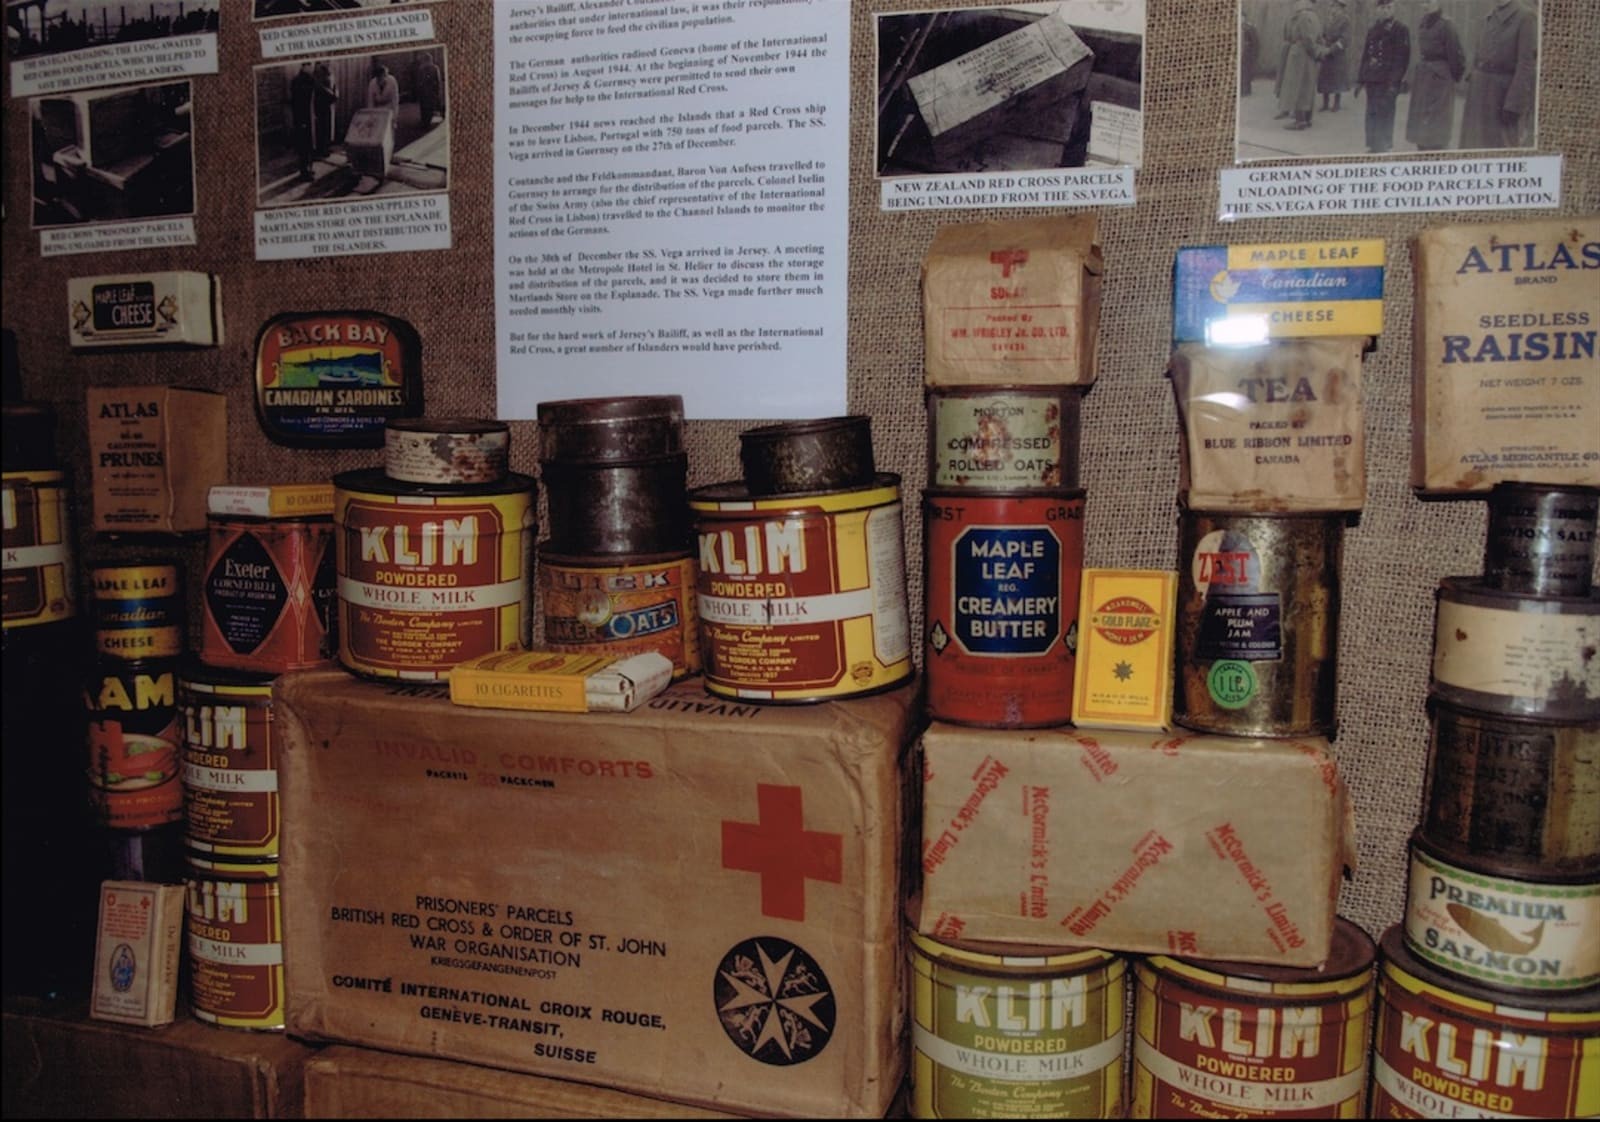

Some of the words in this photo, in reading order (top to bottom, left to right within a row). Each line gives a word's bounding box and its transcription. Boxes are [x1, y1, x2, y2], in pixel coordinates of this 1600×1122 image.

[262, 30, 280, 41] RED
[282, 28, 311, 39] CROSS
[312, 23, 354, 37] SUPPLIES
[356, 18, 387, 30] BEING
[388, 13, 428, 26] LANDED
[275, 45, 285, 53] AT
[288, 42, 304, 50] THE
[307, 38, 351, 48] HARBOUR
[355, 35, 364, 43] IN
[521, 122, 565, 134] December
[569, 120, 590, 130] 1944
[619, 116, 656, 127] reached
[659, 113, 675, 124] the
[678, 111, 712, 123] Islands
[715, 110, 735, 120] that
[749, 106, 768, 118] Red
[772, 105, 801, 116] Cross
[805, 104, 827, 116] ship
[1249, 170, 1312, 182] GERMAN
[1316, 167, 1388, 179] SOLDIERS
[1390, 164, 1457, 176] CARRIED
[1461, 163, 1492, 174] OUT
[1498, 162, 1527, 173] THE
[894, 182, 922, 193] NEW
[925, 179, 985, 192] ZEALAND
[988, 177, 1015, 189] RED
[1019, 175, 1061, 188] CROSS
[1064, 174, 1123, 186] PARCELS
[1238, 185, 1320, 198] UNLOADING
[1322, 183, 1343, 195] OF
[1347, 182, 1377, 194] THE
[1382, 180, 1424, 192] FOOD
[1428, 178, 1493, 191] PARCELS
[1498, 176, 1542, 189] FROM
[887, 196, 925, 208] BEING
[929, 193, 998, 206] UNLOADED
[1001, 192, 1040, 203] FROM
[1044, 190, 1070, 202] THE
[1224, 201, 1253, 213] THE
[1318, 199, 1348, 211] FOR
[1353, 197, 1381, 209] THE
[1384, 195, 1451, 208] CIVILIAN
[1251, 249, 1306, 262] MAPLE
[1319, 247, 1359, 260] LEAF
[1456, 243, 1600, 275] ATLAS
[1262, 272, 1349, 289] Canadian
[1514, 275, 1558, 286] BRAND
[112, 303, 153, 325] CHEESE
[1271, 310, 1335, 323] CHEESE
[1479, 312, 1590, 328] SEEDLESS
[347, 323, 389, 344] BAY
[542, 331, 556, 340] the
[558, 331, 580, 340] hard
[607, 329, 616, 339] of
[692, 330, 702, 338] as
[705, 328, 724, 337] well
[727, 329, 737, 337] as
[739, 327, 755, 337] the
[758, 327, 824, 337] International
[1238, 376, 1318, 404] TEA
[1480, 379, 1501, 387] NET
[1505, 378, 1545, 387] WEIGHT
[265, 389, 334, 406] CANADIAN
[337, 389, 402, 406] SARDINES
[100, 402, 158, 418] ATLAS
[973, 406, 1024, 418] MORTON
[1250, 420, 1288, 430] PACKED
[1204, 437, 1238, 450] BLUE
[1243, 436, 1291, 449] RIBBON
[1298, 434, 1352, 448] LIMITED
[100, 452, 163, 467] PRUNES
[949, 459, 1005, 471] ROLLED
[1016, 459, 1053, 471] OATS
[1255, 454, 1300, 465] CANADA
[1461, 454, 1498, 463] ATLAS
[1503, 452, 1580, 461] MERCANTILE
[360, 515, 479, 566] KLIM
[698, 519, 807, 575] KLIM
[971, 540, 1045, 558] MAPLE
[225, 558, 270, 579] Exeter
[981, 562, 1035, 580] LEAF
[1198, 552, 1250, 585] ZEST
[135, 577, 168, 590] LEAF
[375, 570, 458, 587] POWDERED
[997, 582, 1020, 593] REG.
[362, 586, 420, 604] WHOLE
[432, 589, 476, 604] MILK
[712, 582, 786, 597] POWDERED
[704, 600, 751, 617] WHOLE
[761, 601, 808, 616] MILK
[958, 596, 1056, 616] CREAMERY
[1214, 607, 1242, 617] APPLE
[1247, 607, 1270, 617] AND
[610, 607, 674, 639] OATS
[971, 620, 1047, 638] BUTTER
[1227, 618, 1254, 628] PLUM
[104, 636, 154, 648] CHEESE
[1227, 629, 1252, 638] JAM
[475, 683, 489, 696] 10
[492, 683, 563, 699] CIGARETTES
[376, 739, 477, 766] INVALID
[500, 751, 655, 779] COMFORTS
[208, 769, 245, 785] MILK
[1215, 822, 1273, 902] McCormick's
[1265, 902, 1305, 949] Limited
[1429, 876, 1566, 920] PREMIUM
[415, 895, 500, 918] PRISONERS'
[507, 905, 574, 926] PARCELS
[331, 906, 385, 926] BRITISH
[391, 913, 421, 930] RED
[427, 917, 475, 936] CROSS
[482, 921, 494, 937] &
[500, 924, 553, 944] ORDER
[559, 929, 582, 947] OF
[588, 933, 611, 952] ST.
[617, 938, 666, 958] JOHN
[211, 940, 246, 958] MILK
[409, 933, 447, 952] WAR
[454, 938, 581, 968] ORGANISATION
[1425, 928, 1561, 976] SALMON
[430, 955, 558, 981] KRIEGSGEFANGENENPOST
[332, 974, 393, 994] COMITÉ
[400, 981, 532, 1012] INTERNATIONAL
[540, 1000, 593, 1021] CROIX
[602, 1008, 668, 1031] ROUGE,
[954, 974, 1088, 1031] KLIM
[1178, 1004, 1323, 1059] KLIM
[534, 1042, 597, 1064] SUISSE
[974, 1035, 1067, 1054] POWDERED
[1400, 1010, 1548, 1091] KLIM
[955, 1051, 1028, 1074] WHOLE
[1039, 1055, 1085, 1073] MILK
[1196, 1054, 1296, 1082] POWDERED
[1177, 1068, 1251, 1101] WHOLE
[1264, 1085, 1315, 1102] MILK
[1412, 1066, 1513, 1113] POWDERED
[1396, 1077, 1463, 1118] WHOLE
